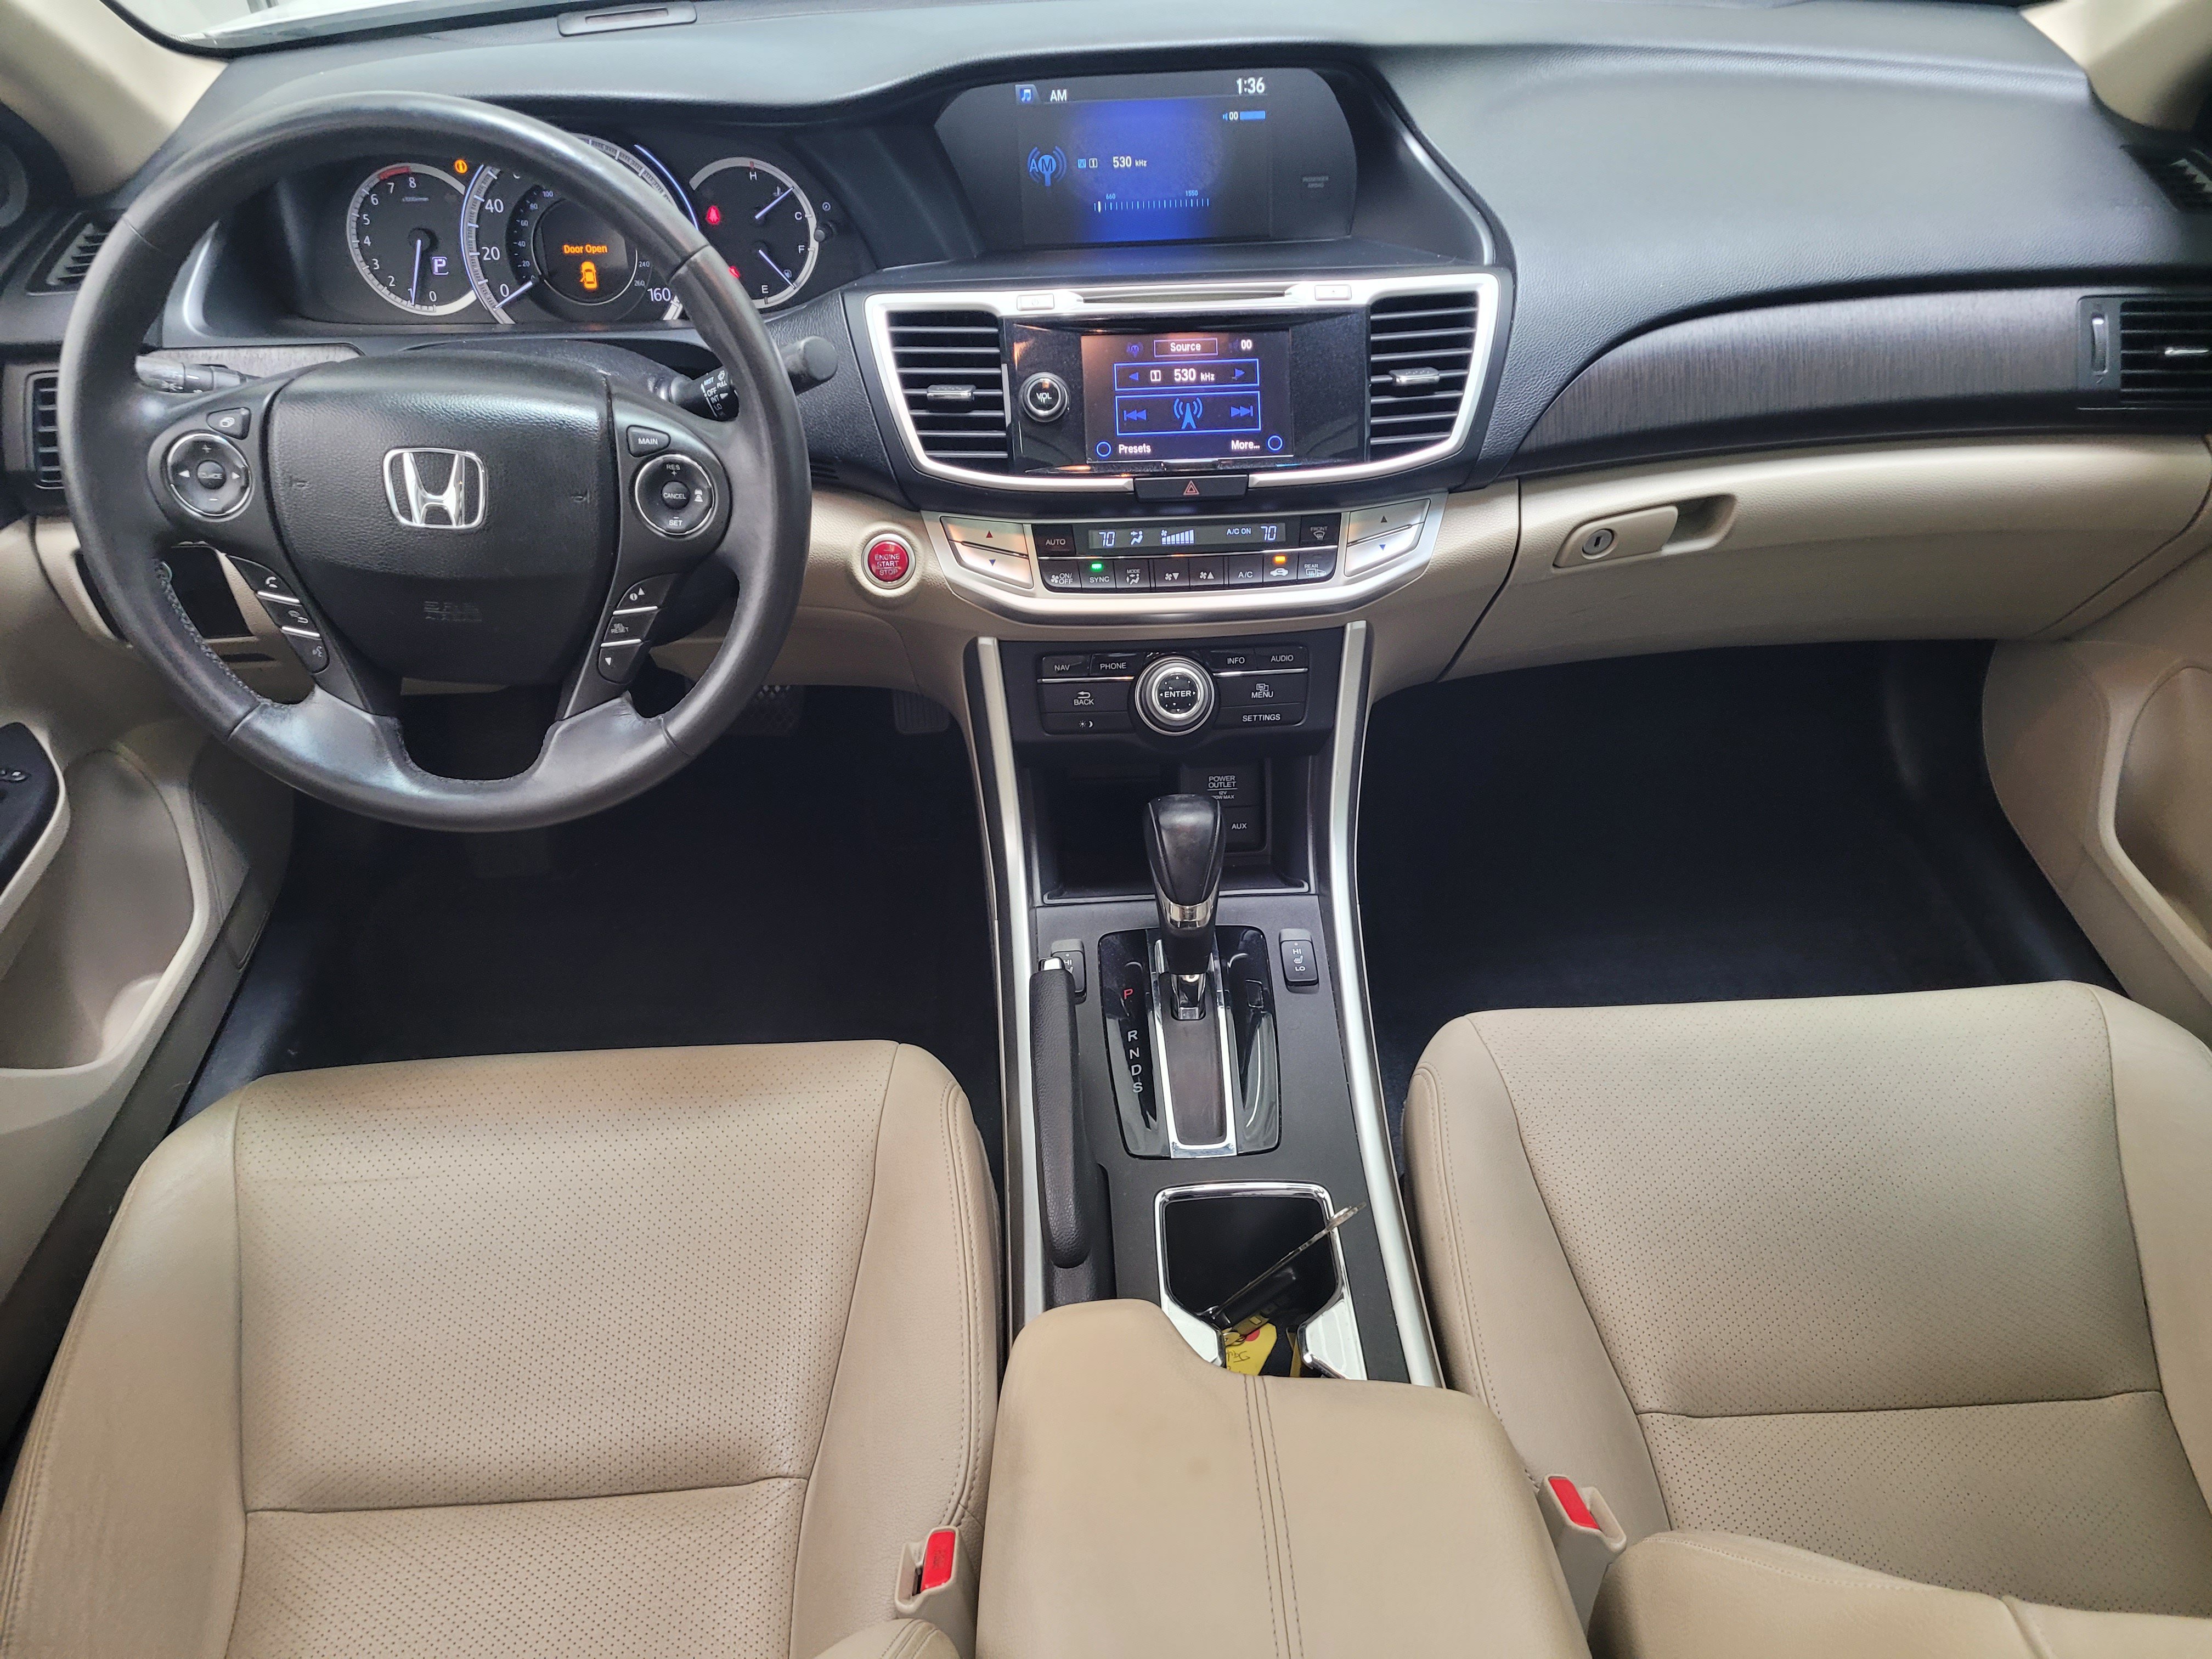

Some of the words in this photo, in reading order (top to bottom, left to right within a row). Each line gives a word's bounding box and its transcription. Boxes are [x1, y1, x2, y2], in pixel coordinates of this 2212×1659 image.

[1237, 77, 1265, 94] 1:36
[1050, 89, 1067, 101] AM
[1229, 111, 1238, 121] 00
[1113, 156, 1132, 168] 530
[1135, 159, 1147, 167] kHz
[749, 171, 757, 180] H
[387, 183, 395, 193] 7
[409, 177, 416, 188] 8
[371, 194, 379, 205] 6
[485, 198, 504, 213] 40
[363, 215, 370, 225] 5
[795, 212, 802, 220] C
[363, 236, 371, 246] 4
[482, 247, 500, 261] 20
[563, 245, 583, 254] Door
[585, 244, 608, 254] Open
[798, 245, 805, 253] F
[373, 259, 380, 269] 3
[433, 258, 446, 273] P
[387, 276, 396, 287] 2
[500, 284, 510, 297] 0
[647, 287, 671, 302] 160
[762, 285, 769, 294] E
[429, 291, 437, 302] 0
[1170, 342, 1201, 352] Source
[1241, 340, 1252, 350] 00
[1174, 368, 1197, 381] 530
[1200, 373, 1215, 381] kHz
[707, 387, 717, 397] OFF
[639, 437, 658, 445] MAIN
[1231, 440, 1260, 450] More...
[1119, 443, 1151, 455] Presets
[1099, 531, 1115, 546] 70
[1261, 525, 1277, 541] 70
[1099, 662, 1127, 670] PHONE
[1164, 690, 1192, 698] ENTER
[1074, 698, 1094, 706] BACK
[1242, 714, 1280, 722] SETTINGS
[1124, 989, 1133, 1000] P
[1127, 1030, 1138, 1041] R
[1129, 1048, 1140, 1059] N
[1131, 1064, 1142, 1076] D
[1132, 1082, 1143, 1093] S
